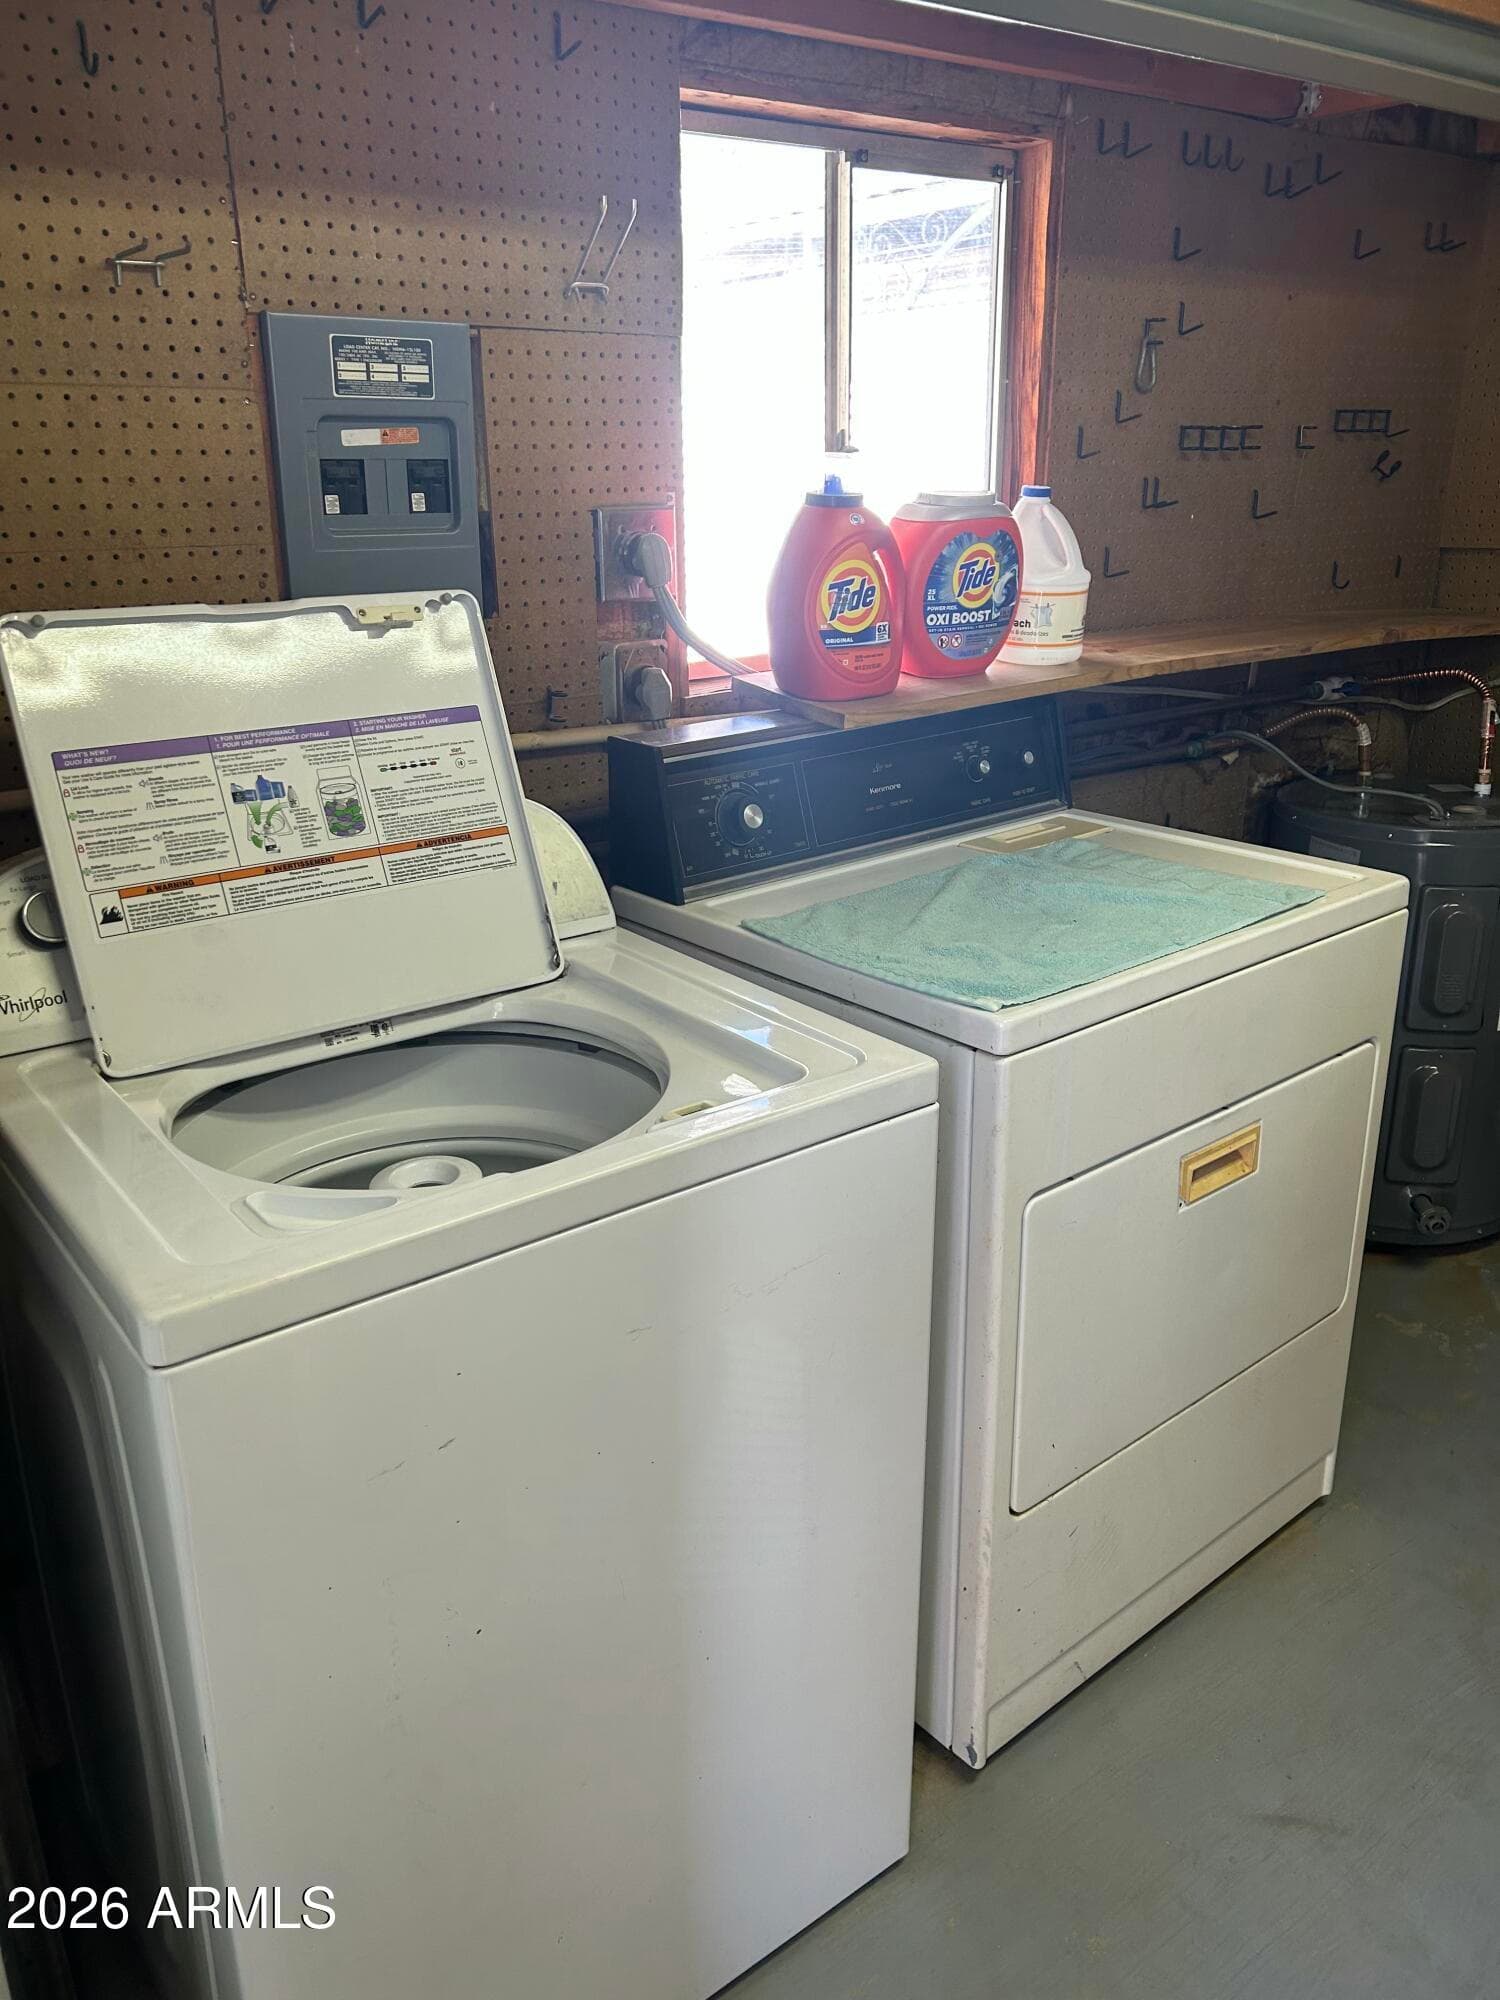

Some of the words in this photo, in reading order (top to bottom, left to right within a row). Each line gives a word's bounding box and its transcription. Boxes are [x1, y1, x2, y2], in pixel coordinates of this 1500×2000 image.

[956, 557, 996, 600] Tide
[827, 576, 876, 623] Tide
[926, 613, 950, 626] OXI
[951, 609, 992, 625] BOOST
[877, 623, 888, 633] 6X
[222, 740, 240, 748] POUR
[869, 783, 901, 795] Kenmore
[423, 834, 472, 847] ADVERTENCIA
[273, 856, 335, 872] AVERTISSEMENT
[155, 879, 195, 892] WARNING
